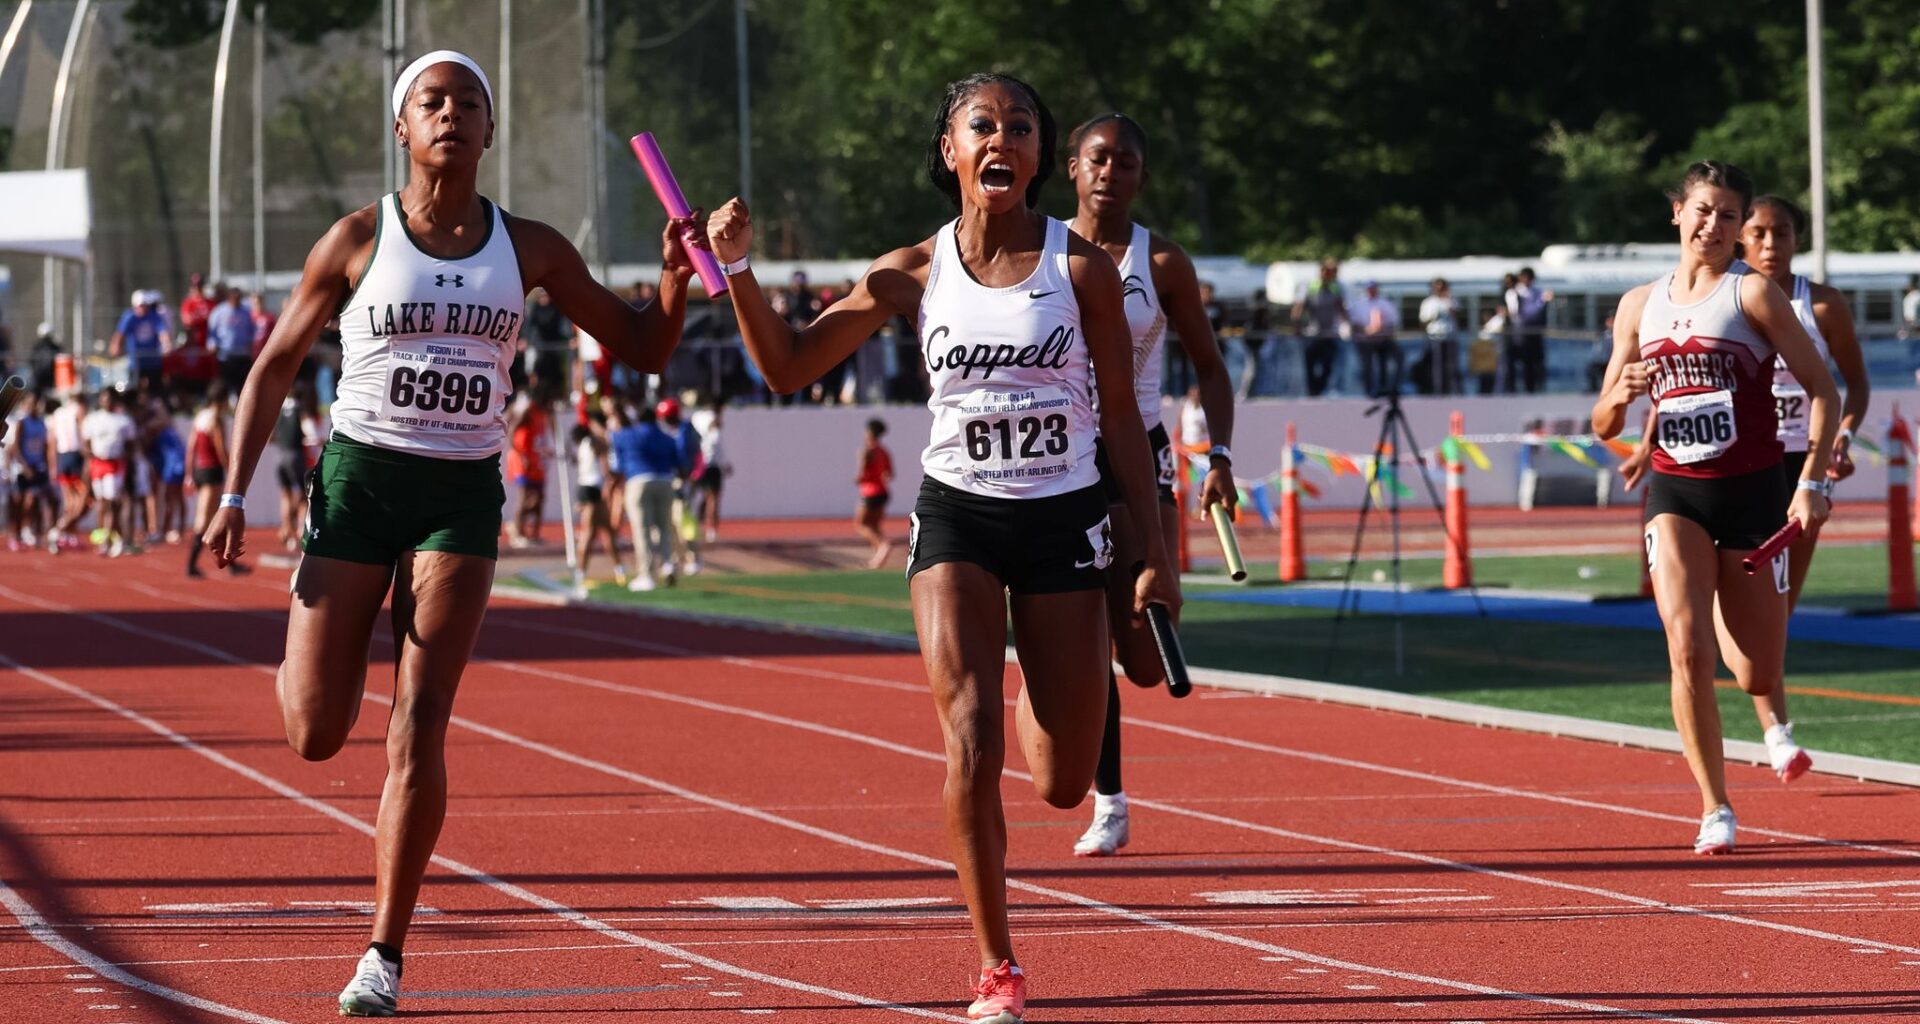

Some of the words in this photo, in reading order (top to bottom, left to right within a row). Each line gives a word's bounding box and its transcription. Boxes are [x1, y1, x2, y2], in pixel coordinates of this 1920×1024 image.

[368, 303, 435, 337] LAKE
[445, 303, 519, 342] RIDGE
[426, 345, 452, 356] REGION
[927, 325, 1075, 380] Coppell
[392, 351, 414, 361] TRACK
[415, 355, 428, 363] AND
[429, 356, 446, 365] FIELD
[447, 358, 496, 370] CHAMPIONSHIPS
[389, 366, 491, 416] 6399
[994, 393, 1020, 403] REGION
[961, 406, 982, 414] TRACK
[983, 405, 997, 413] AND
[998, 403, 1016, 412] FIELD
[1017, 398, 1070, 412] CHAMPIONSHIPS
[390, 415, 418, 426] HOSTED
[419, 419, 430, 427] BY
[1663, 411, 1731, 449] 6306
[965, 413, 1069, 462] 6123
[973, 470, 1002, 480] HOSTED
[1003, 469, 1015, 478] BY
